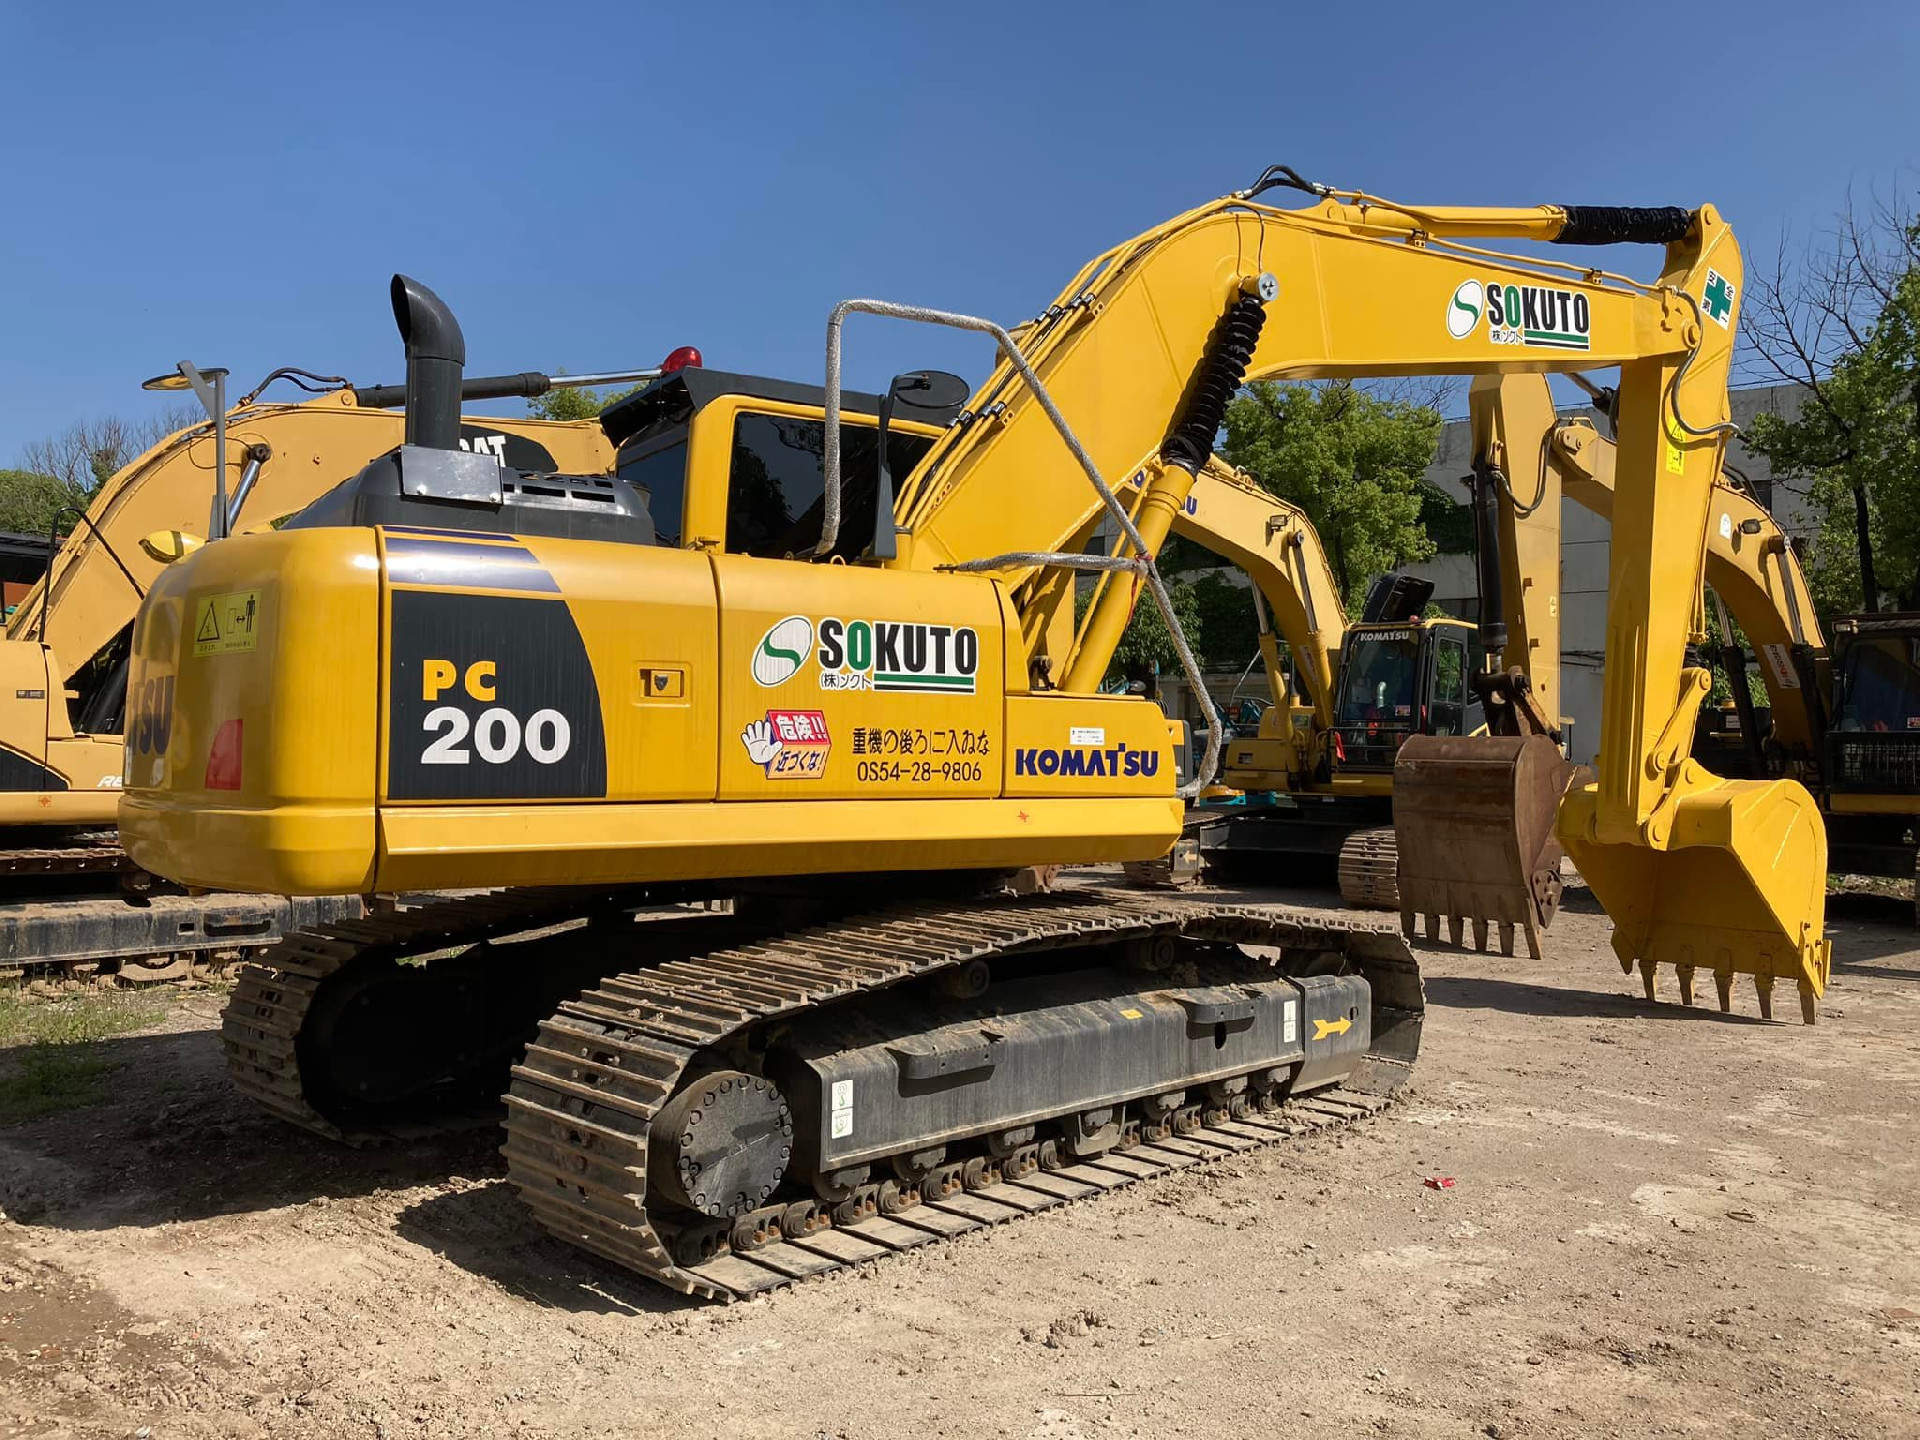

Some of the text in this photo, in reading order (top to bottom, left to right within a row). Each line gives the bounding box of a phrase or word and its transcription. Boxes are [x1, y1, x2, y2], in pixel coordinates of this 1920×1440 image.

[1486, 284, 1589, 333] SOKUTO
[819, 619, 977, 675] SOKUTO
[1360, 630, 1410, 641] KOMATSU
[422, 659, 496, 702] PC
[421, 706, 571, 765] 200
[1015, 742, 1158, 777] KOMATSU
